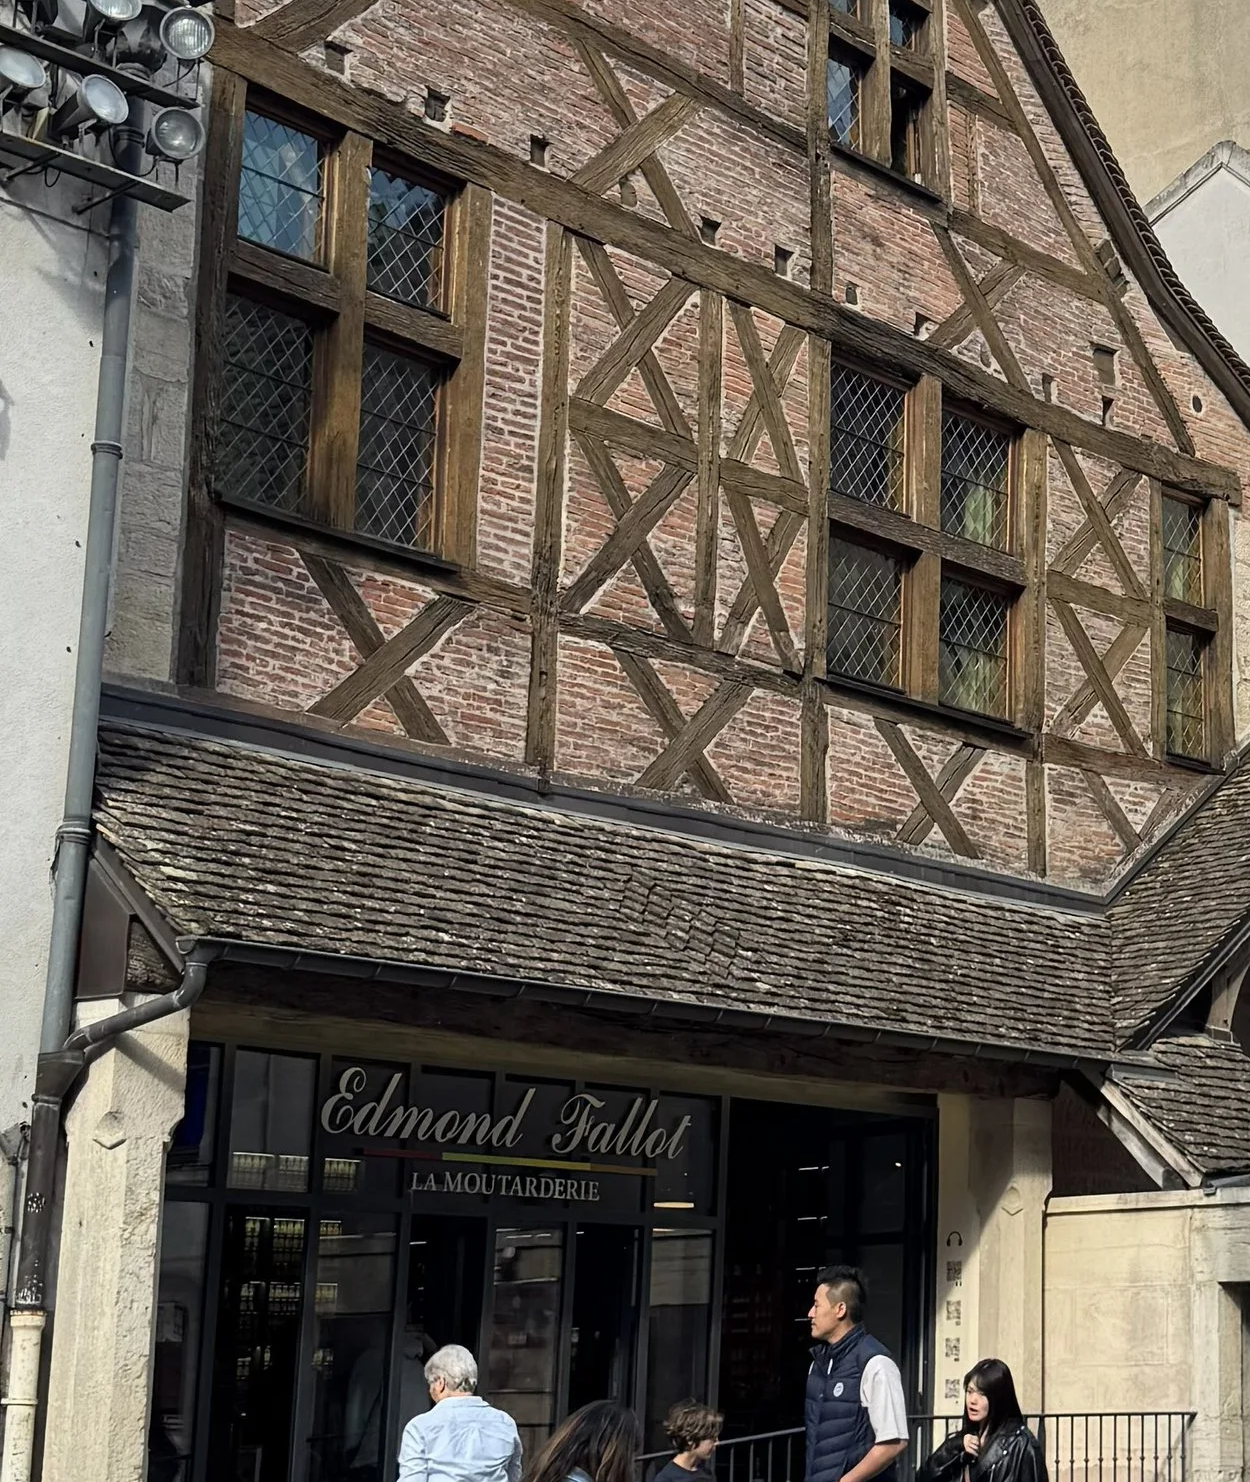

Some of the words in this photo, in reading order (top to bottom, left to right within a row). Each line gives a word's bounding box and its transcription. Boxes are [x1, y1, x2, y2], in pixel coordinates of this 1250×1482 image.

[320, 1067, 536, 1148] Edmond
[552, 1093, 692, 1160] Fallot
[411, 1172, 437, 1192] LA
[443, 1171, 600, 1202] MOUTARDERIE
